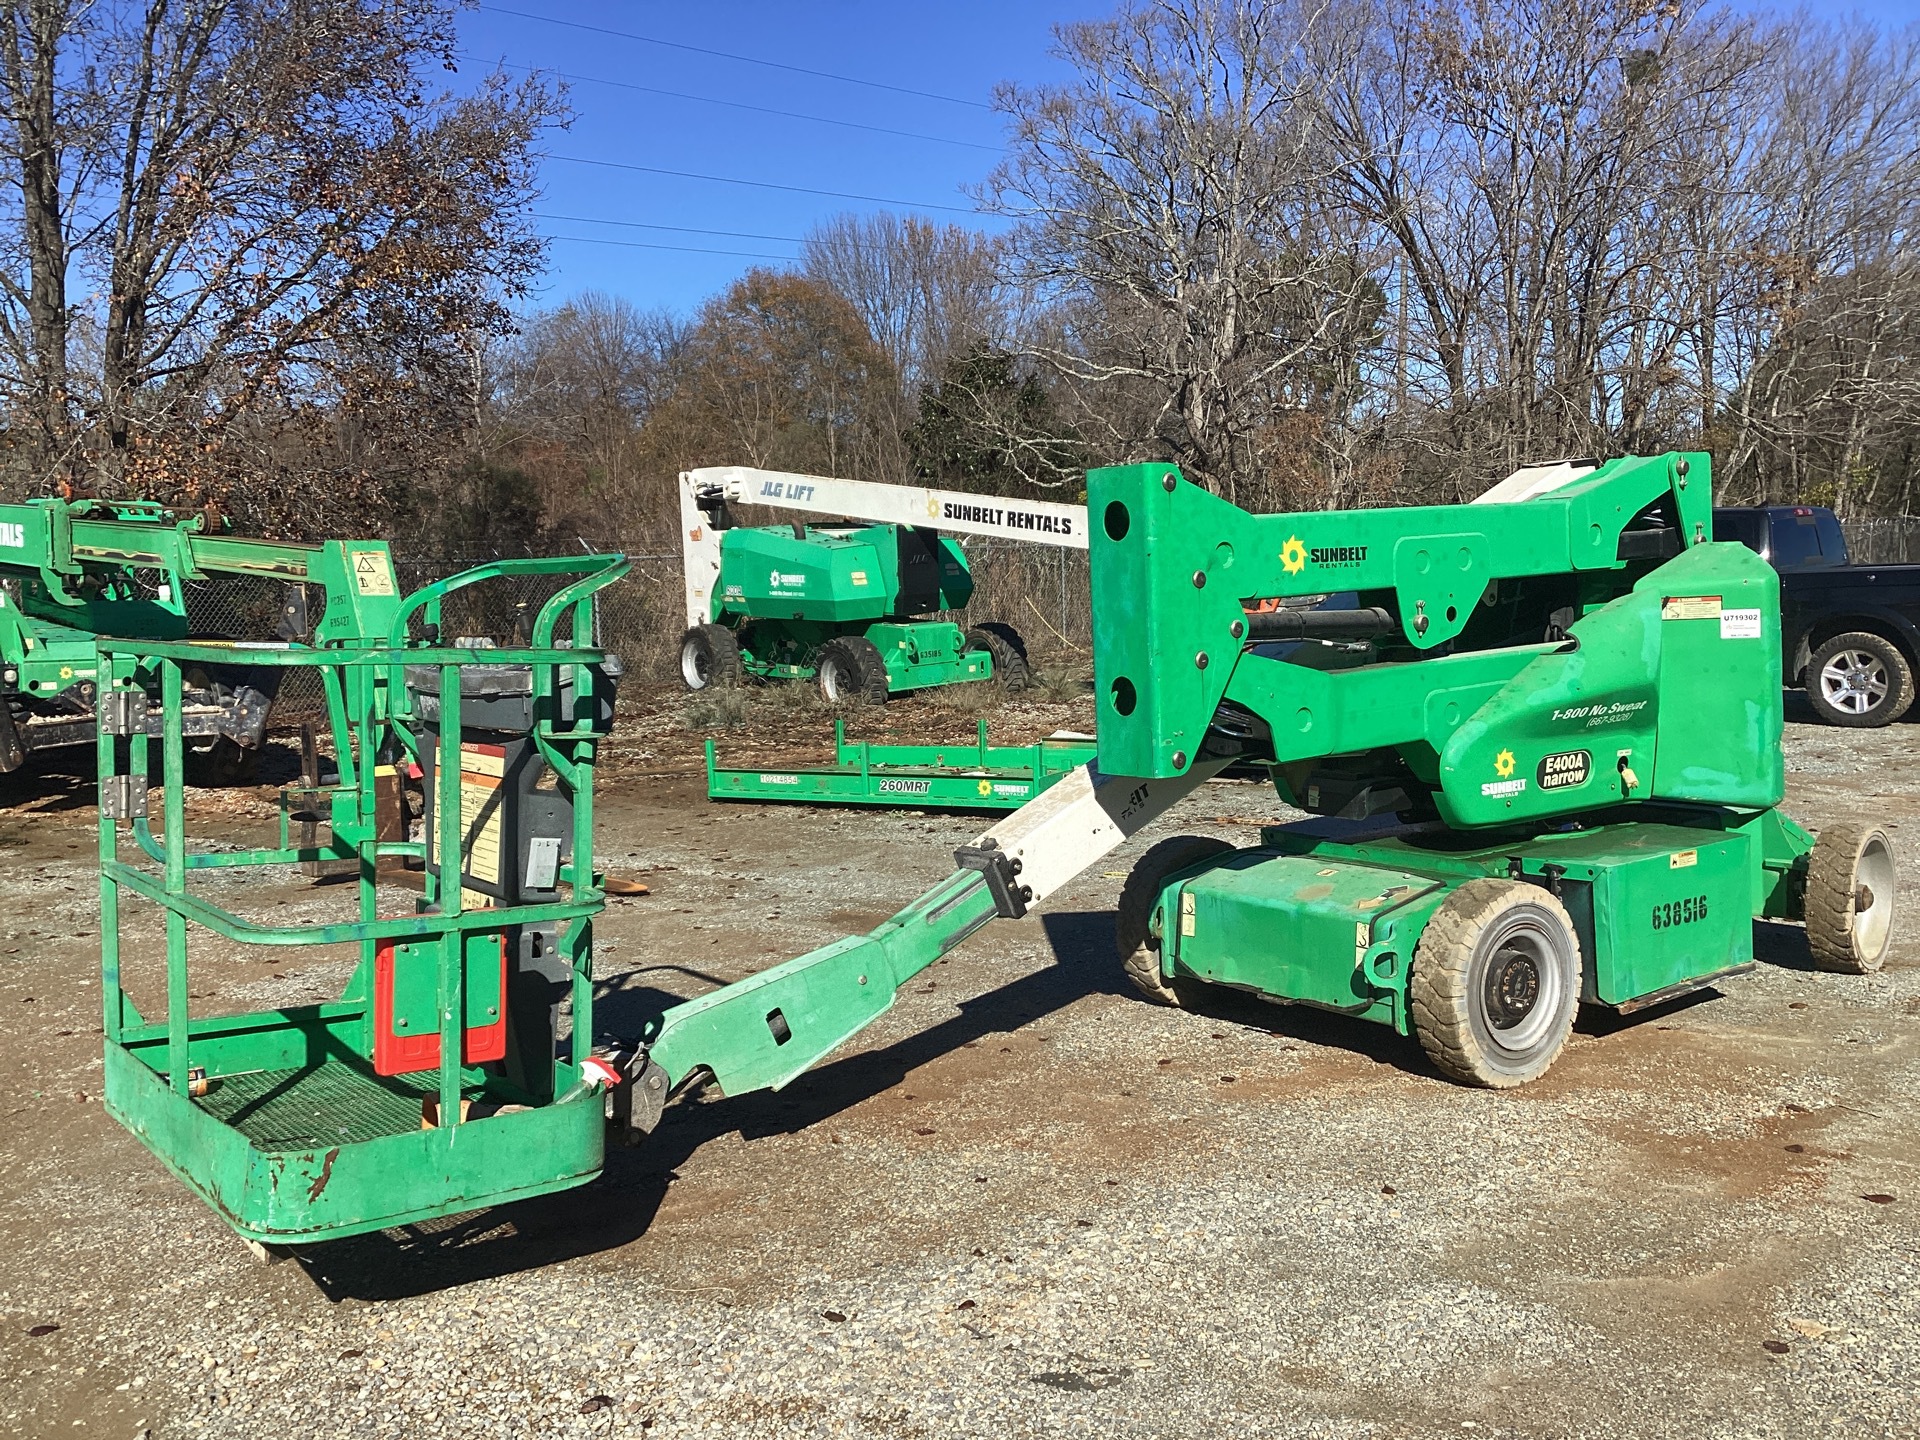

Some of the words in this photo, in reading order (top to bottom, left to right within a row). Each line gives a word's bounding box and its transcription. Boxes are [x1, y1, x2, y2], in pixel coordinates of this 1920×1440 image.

[760, 481, 784, 497] JLG
[785, 484, 815, 501] LIFT
[944, 502, 1003, 526] SUNBELT
[1006, 510, 1072, 535] RENTALS
[1310, 546, 1368, 563] SUNBELT
[1552, 706, 1590, 720] 1-800
[1588, 704, 1608, 716] No
[1608, 700, 1648, 713] Sweat
[1545, 753, 1584, 773] E400A
[760, 774, 798, 784] 10214854
[879, 779, 931, 793] 260MRT
[1543, 768, 1586, 787] narrow
[993, 784, 1029, 793] SUNBELT
[1481, 779, 1527, 795] SUNBELT
[1492, 791, 1519, 799] RENTALS
[1652, 894, 1708, 930] 638516
